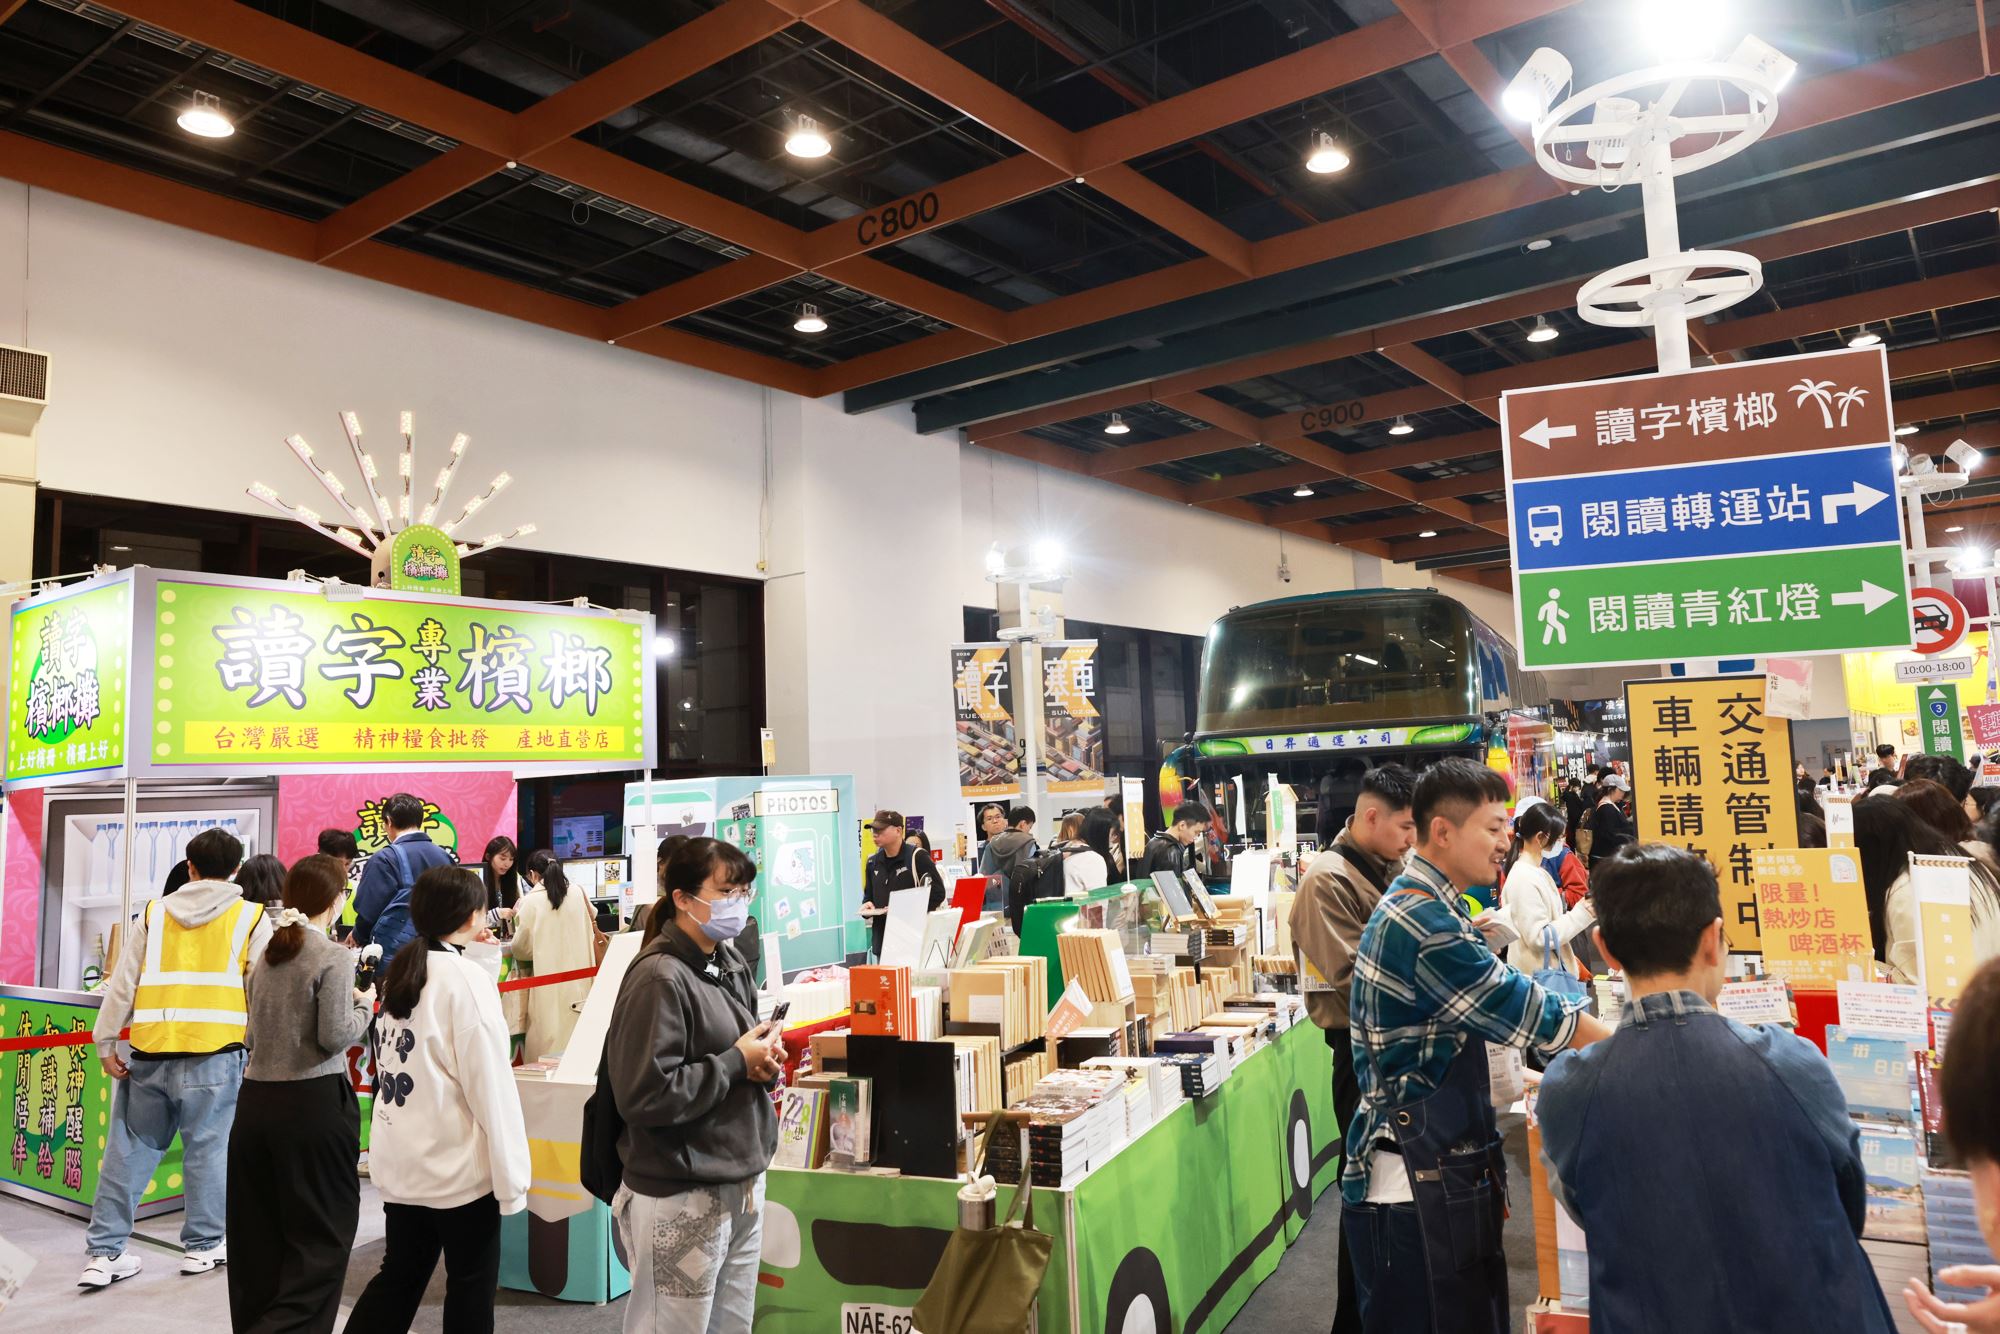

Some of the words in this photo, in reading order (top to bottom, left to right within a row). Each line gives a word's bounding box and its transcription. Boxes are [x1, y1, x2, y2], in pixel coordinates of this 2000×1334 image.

[858, 191, 939, 246] C800
[1301, 401, 1364, 431] C900
[1595, 391, 1777, 446] 讀字檳榔
[1581, 483, 1811, 539] 閱讀轉運站
[1588, 582, 1821, 634] 閱讀青紅燈
[40, 607, 89, 675] 讀字
[410, 617, 451, 711] 專業
[956, 658, 1008, 711] 讀字
[1043, 656, 1096, 708] 塞車
[1903, 661, 1965, 675] 10:00-18:00
[24, 671, 101, 739] 檳榔攤
[1935, 704, 1943, 713] 3
[354, 726, 489, 750] 精神糧食批發
[516, 727, 609, 749] 產地直營店
[1265, 731, 1391, 750] 日昇通運公司
[1932, 719, 1953, 752] 閱讀
[1652, 695, 1708, 858] 車輛請
[767, 795, 829, 813] PHOTOS
[1763, 907, 1836, 929] 熱炒店
[1789, 932, 1866, 956] 啤酒杯
[62, 1016, 87, 1192] 提神醒腦
